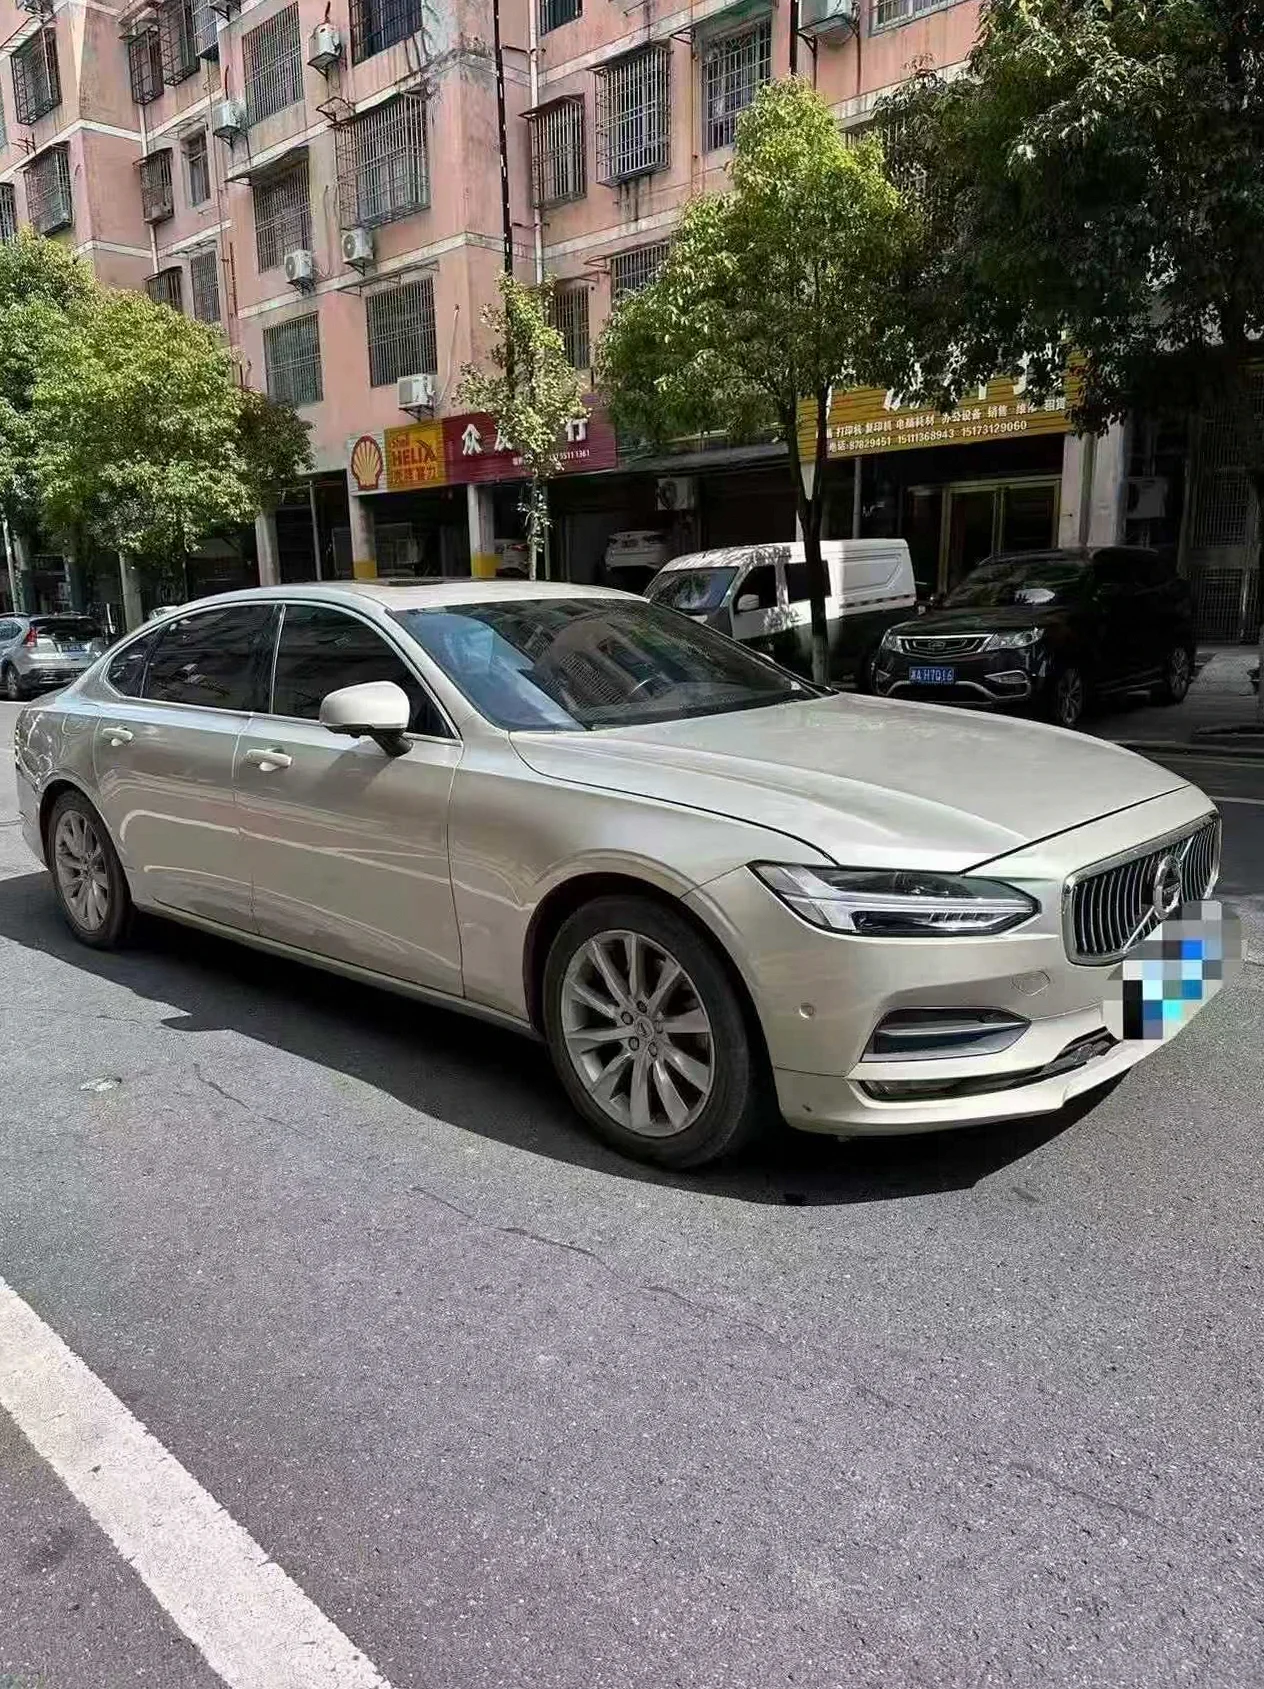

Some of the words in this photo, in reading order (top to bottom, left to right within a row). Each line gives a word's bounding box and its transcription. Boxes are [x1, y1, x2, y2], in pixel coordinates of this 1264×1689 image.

[896, 414, 935, 429] 电脑耗材
[941, 408, 982, 424] 办公设备
[962, 420, 1028, 437] 15173129060
